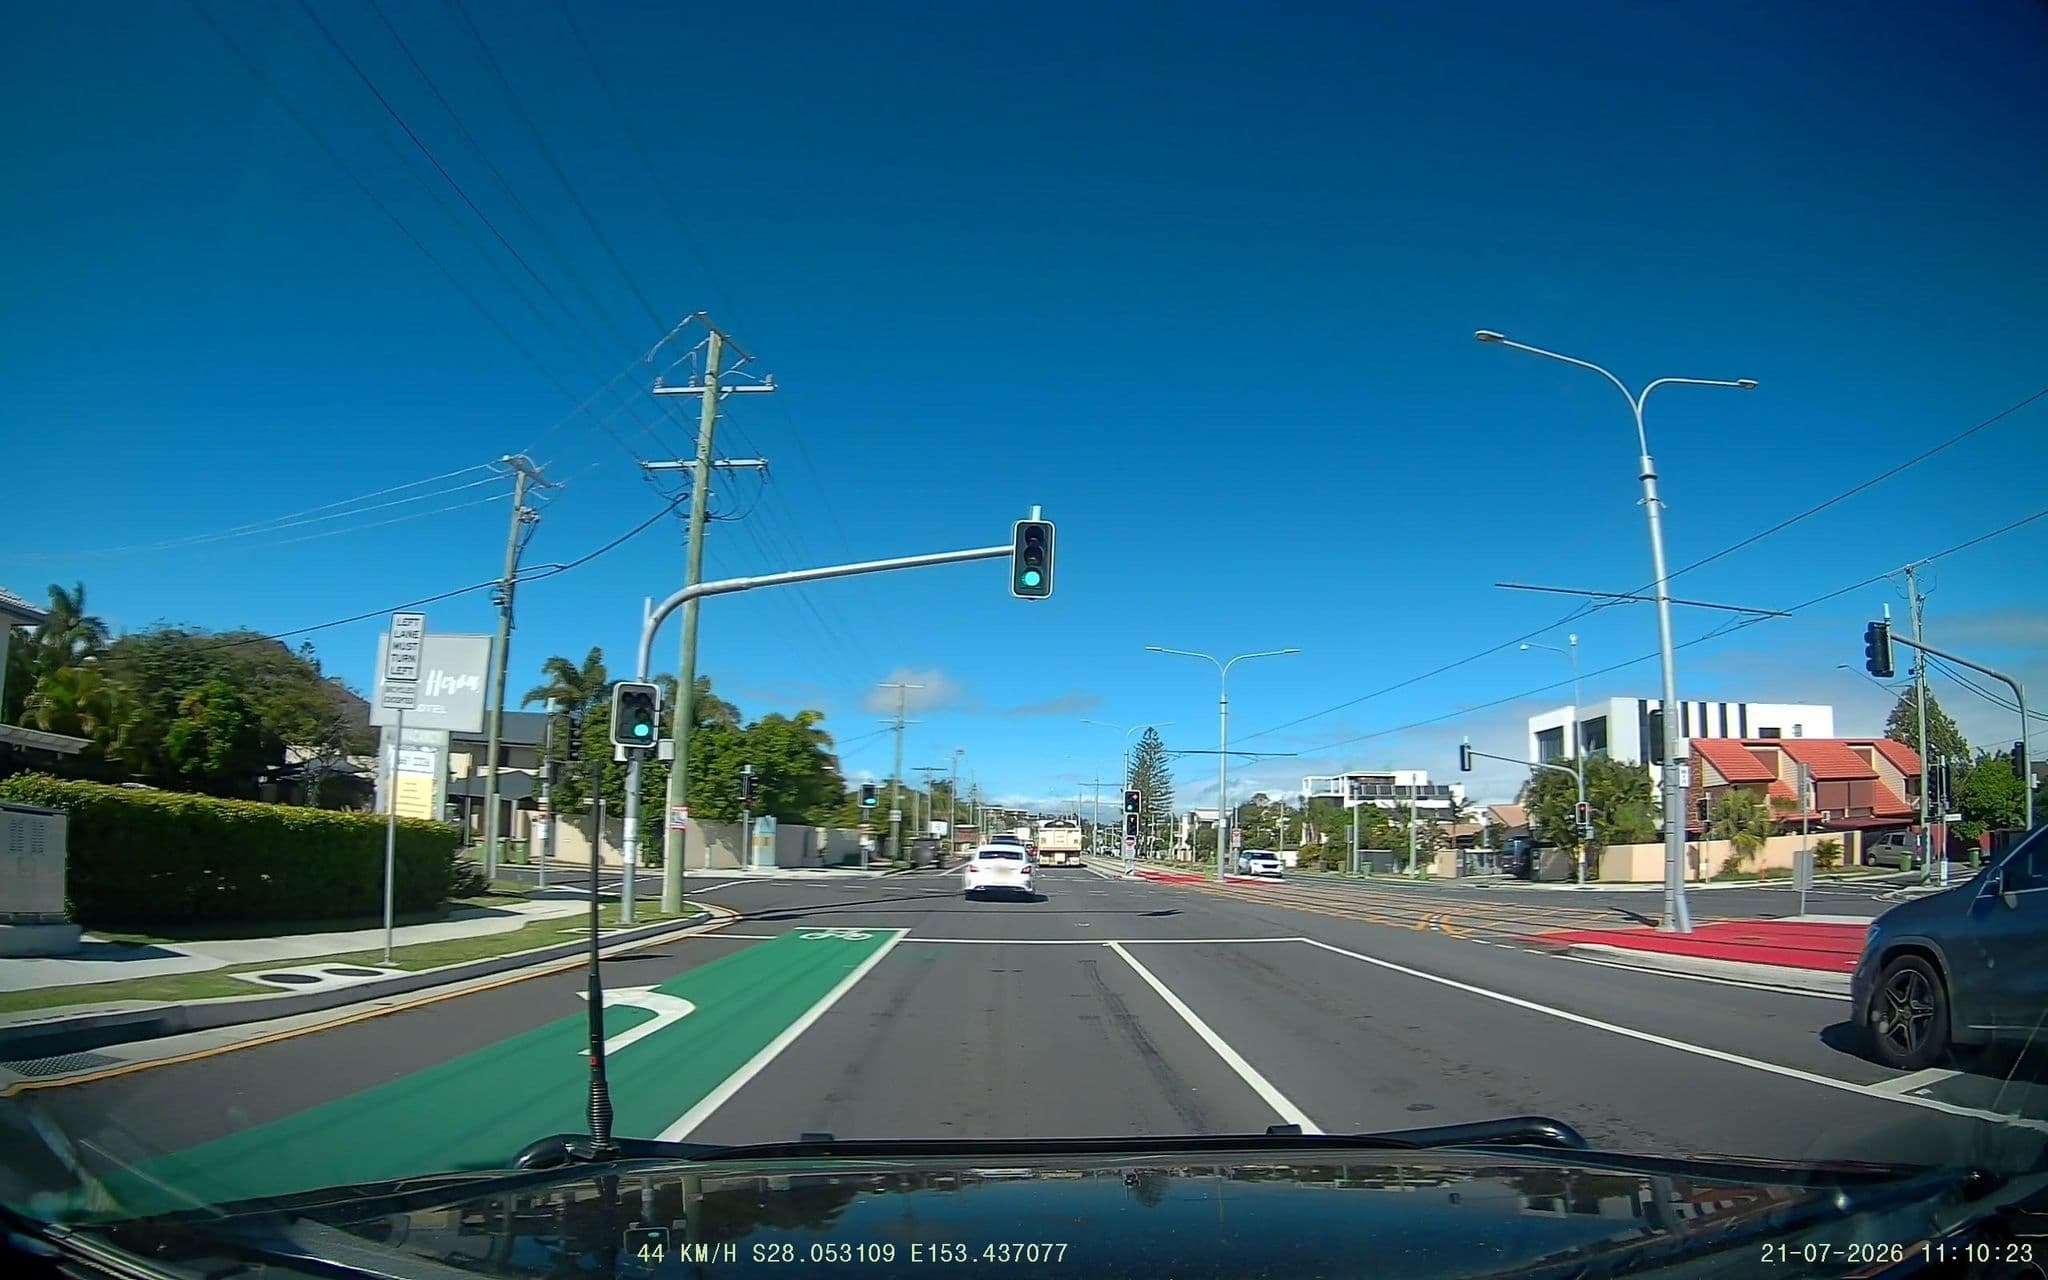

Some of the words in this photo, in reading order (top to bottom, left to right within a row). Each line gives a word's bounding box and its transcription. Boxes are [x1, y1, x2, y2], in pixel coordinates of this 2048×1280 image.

[396, 617, 421, 627] LEFT
[393, 630, 419, 639] LANE
[392, 642, 419, 651] MUST
[390, 654, 417, 663] TURN
[390, 666, 415, 676] LEFT
[415, 703, 448, 714] OTEL
